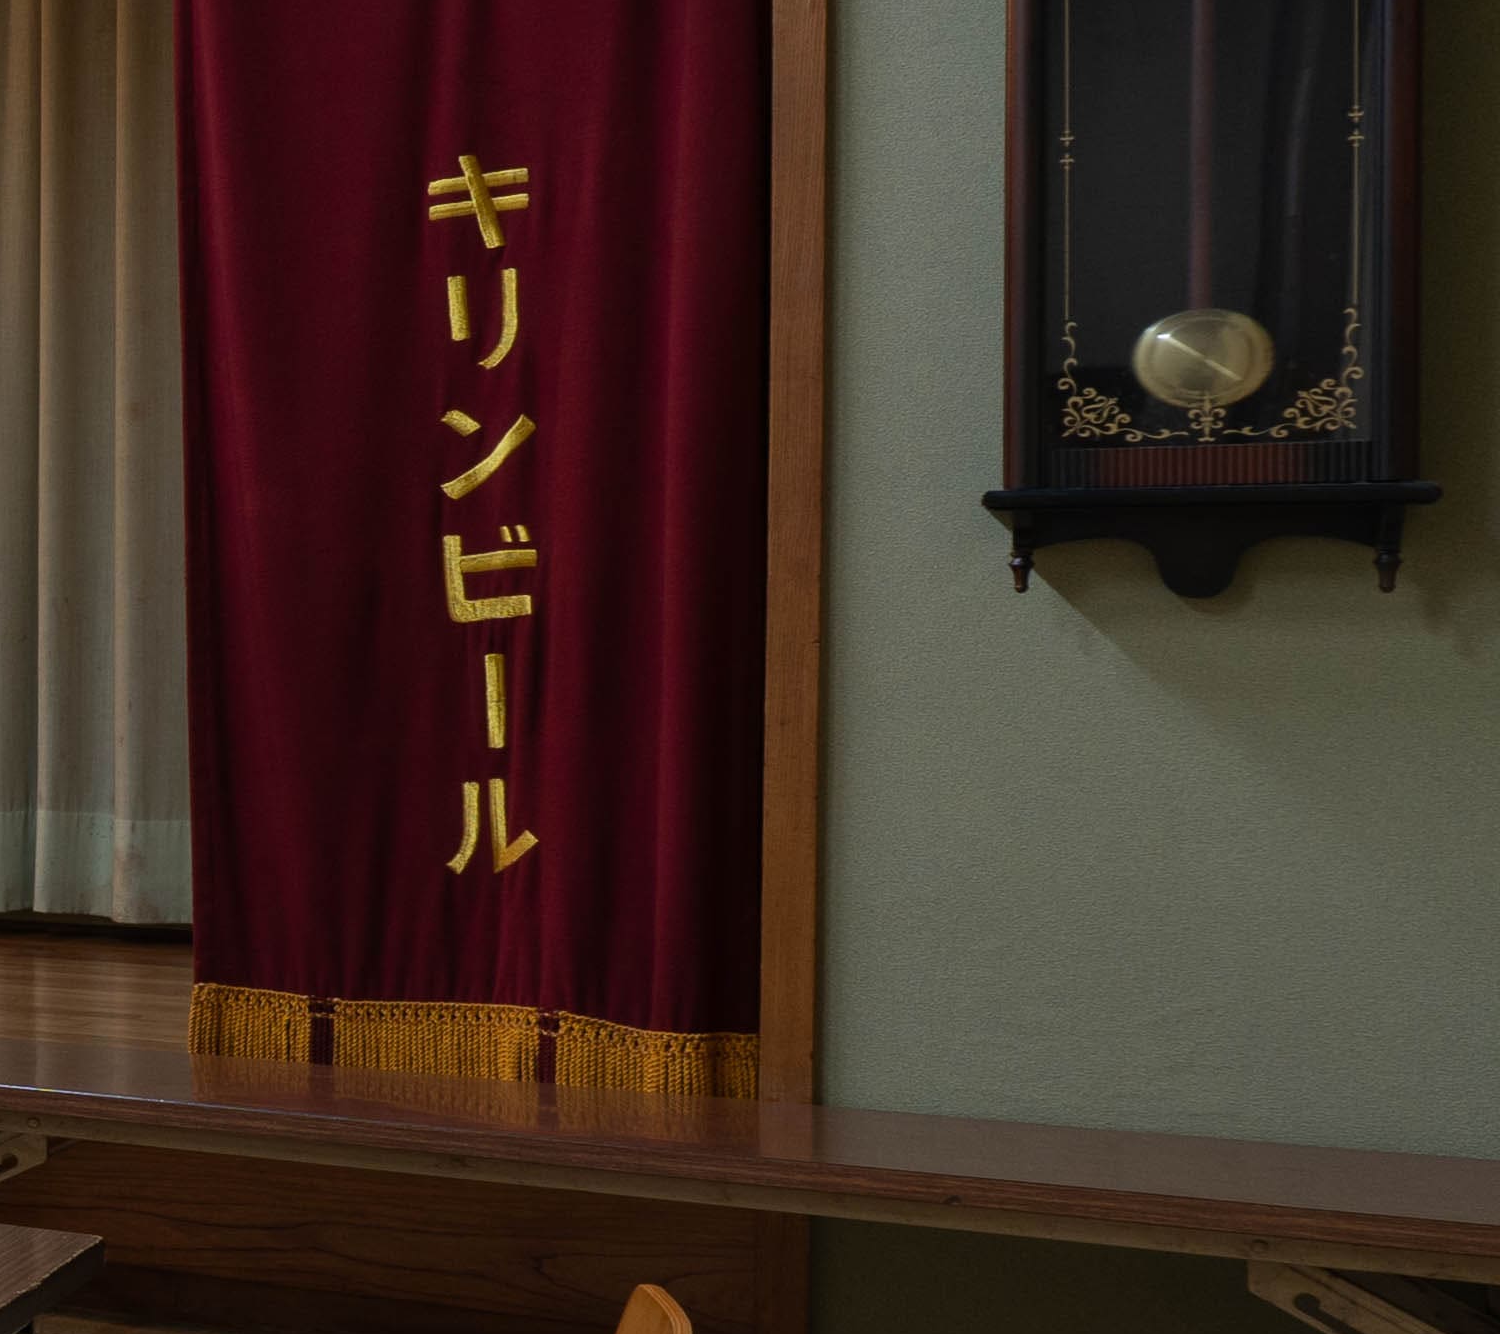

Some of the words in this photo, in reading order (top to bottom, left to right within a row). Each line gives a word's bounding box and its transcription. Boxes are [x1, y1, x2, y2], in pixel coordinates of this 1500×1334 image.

[427, 153, 540, 875] キリンビール
